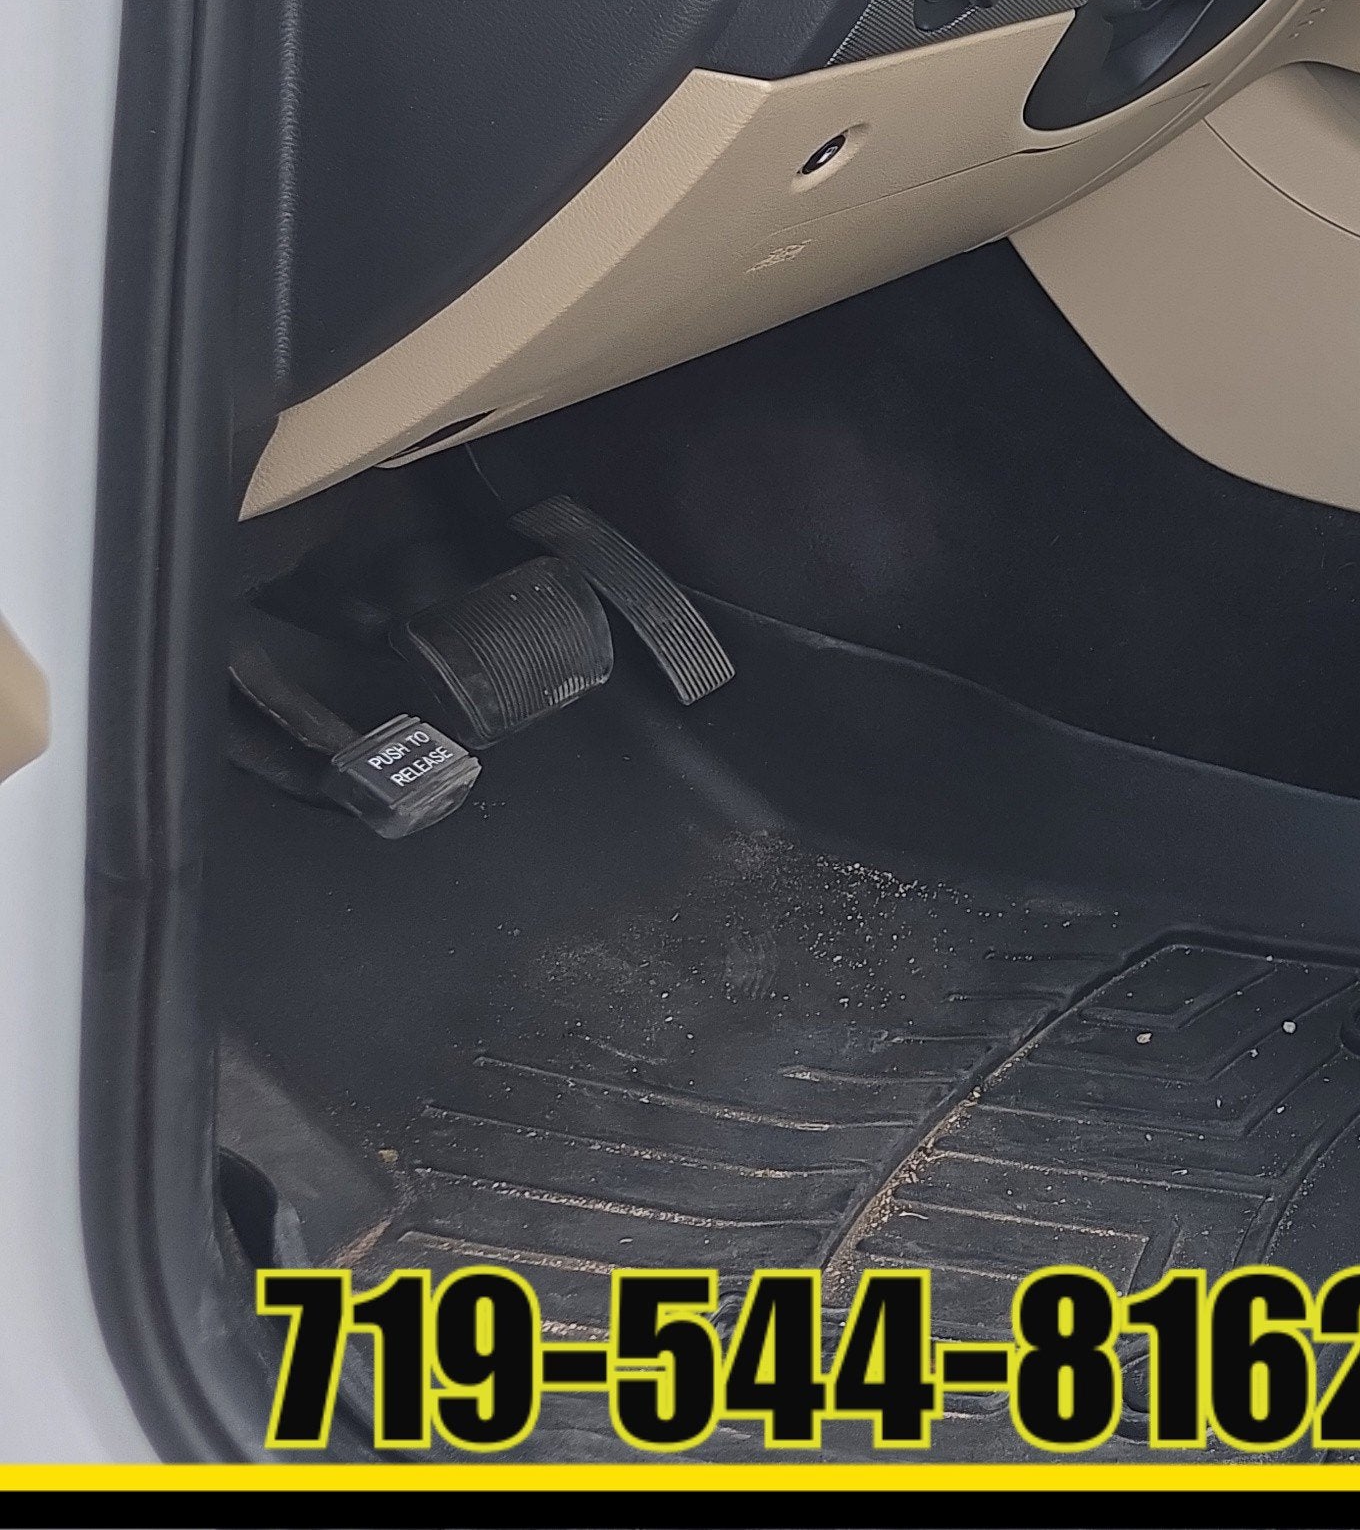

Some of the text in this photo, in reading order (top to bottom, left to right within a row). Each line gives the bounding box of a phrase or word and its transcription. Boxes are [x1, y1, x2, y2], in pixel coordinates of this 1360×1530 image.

[367, 730, 430, 771] PUSH TO
[390, 745, 454, 787] RELEASE
